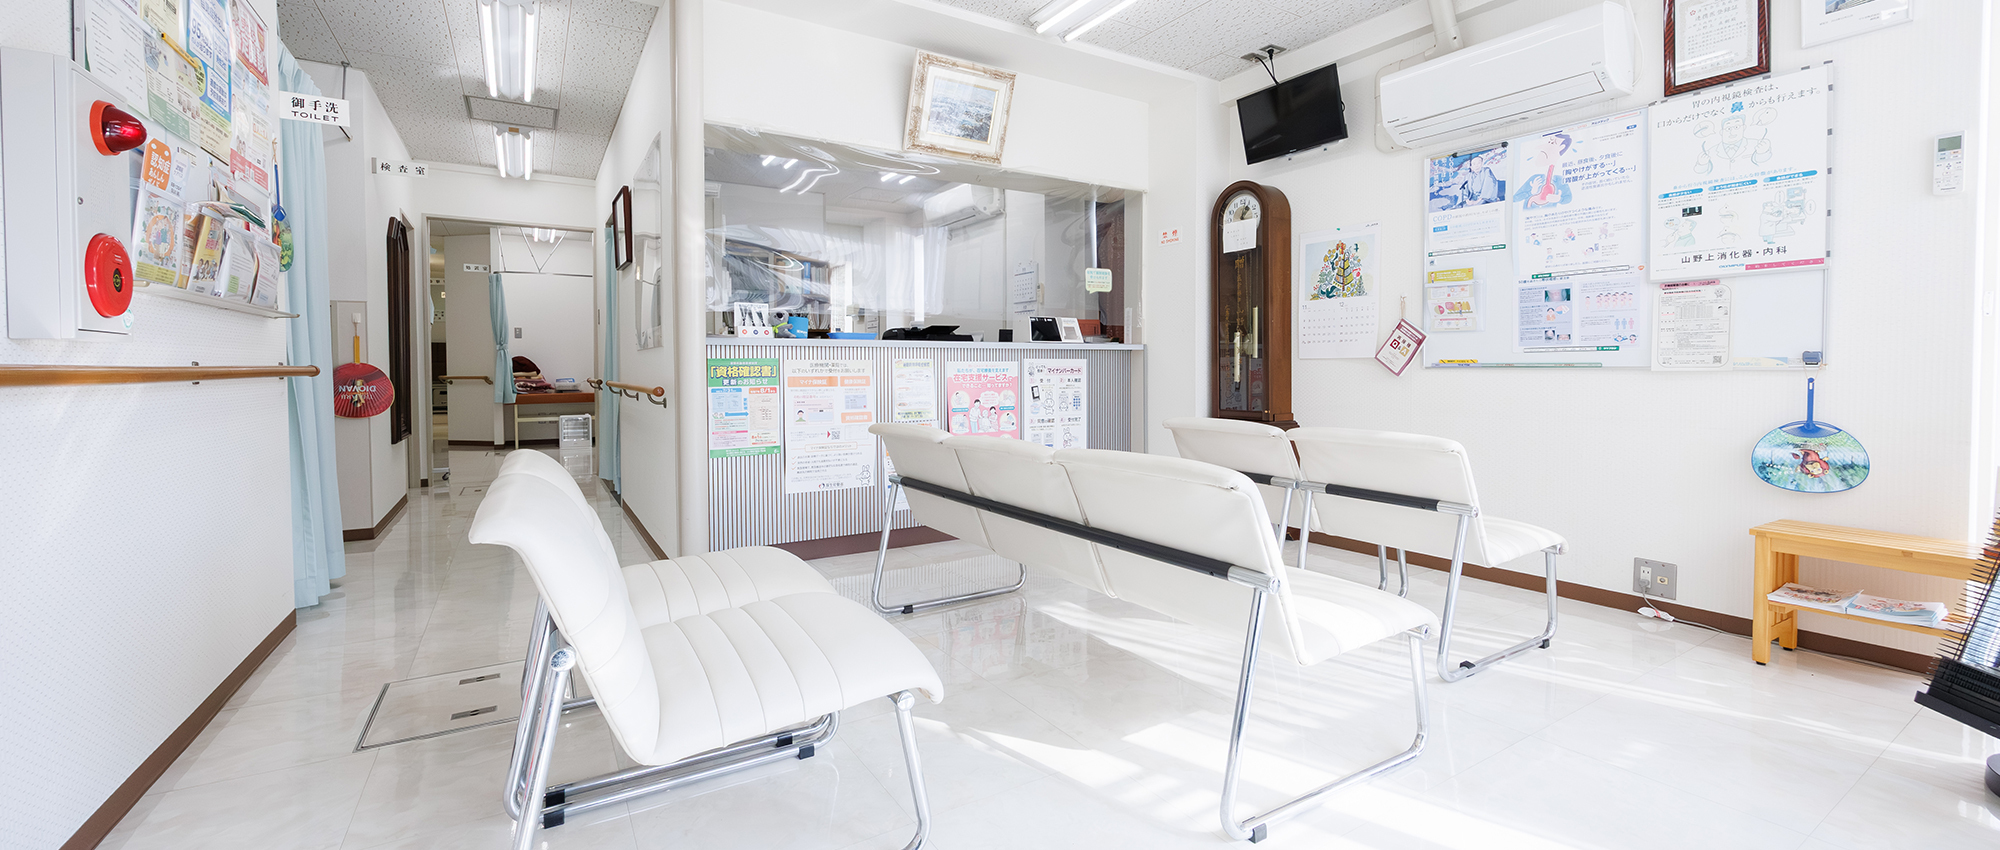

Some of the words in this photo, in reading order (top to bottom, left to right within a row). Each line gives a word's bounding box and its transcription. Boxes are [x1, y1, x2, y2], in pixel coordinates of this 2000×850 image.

[1692, 84, 1779, 109] 胃の内視鏡検査は、
[291, 96, 339, 114] 御手洗
[291, 111, 339, 122] TOILET
[150, 151, 171, 175] 認知症
[380, 162, 426, 175] 検査室
[1433, 214, 1452, 222] COPD
[1681, 246, 1787, 264] 山野上消化器・内科
[710, 365, 777, 378] 「資格確認書」
